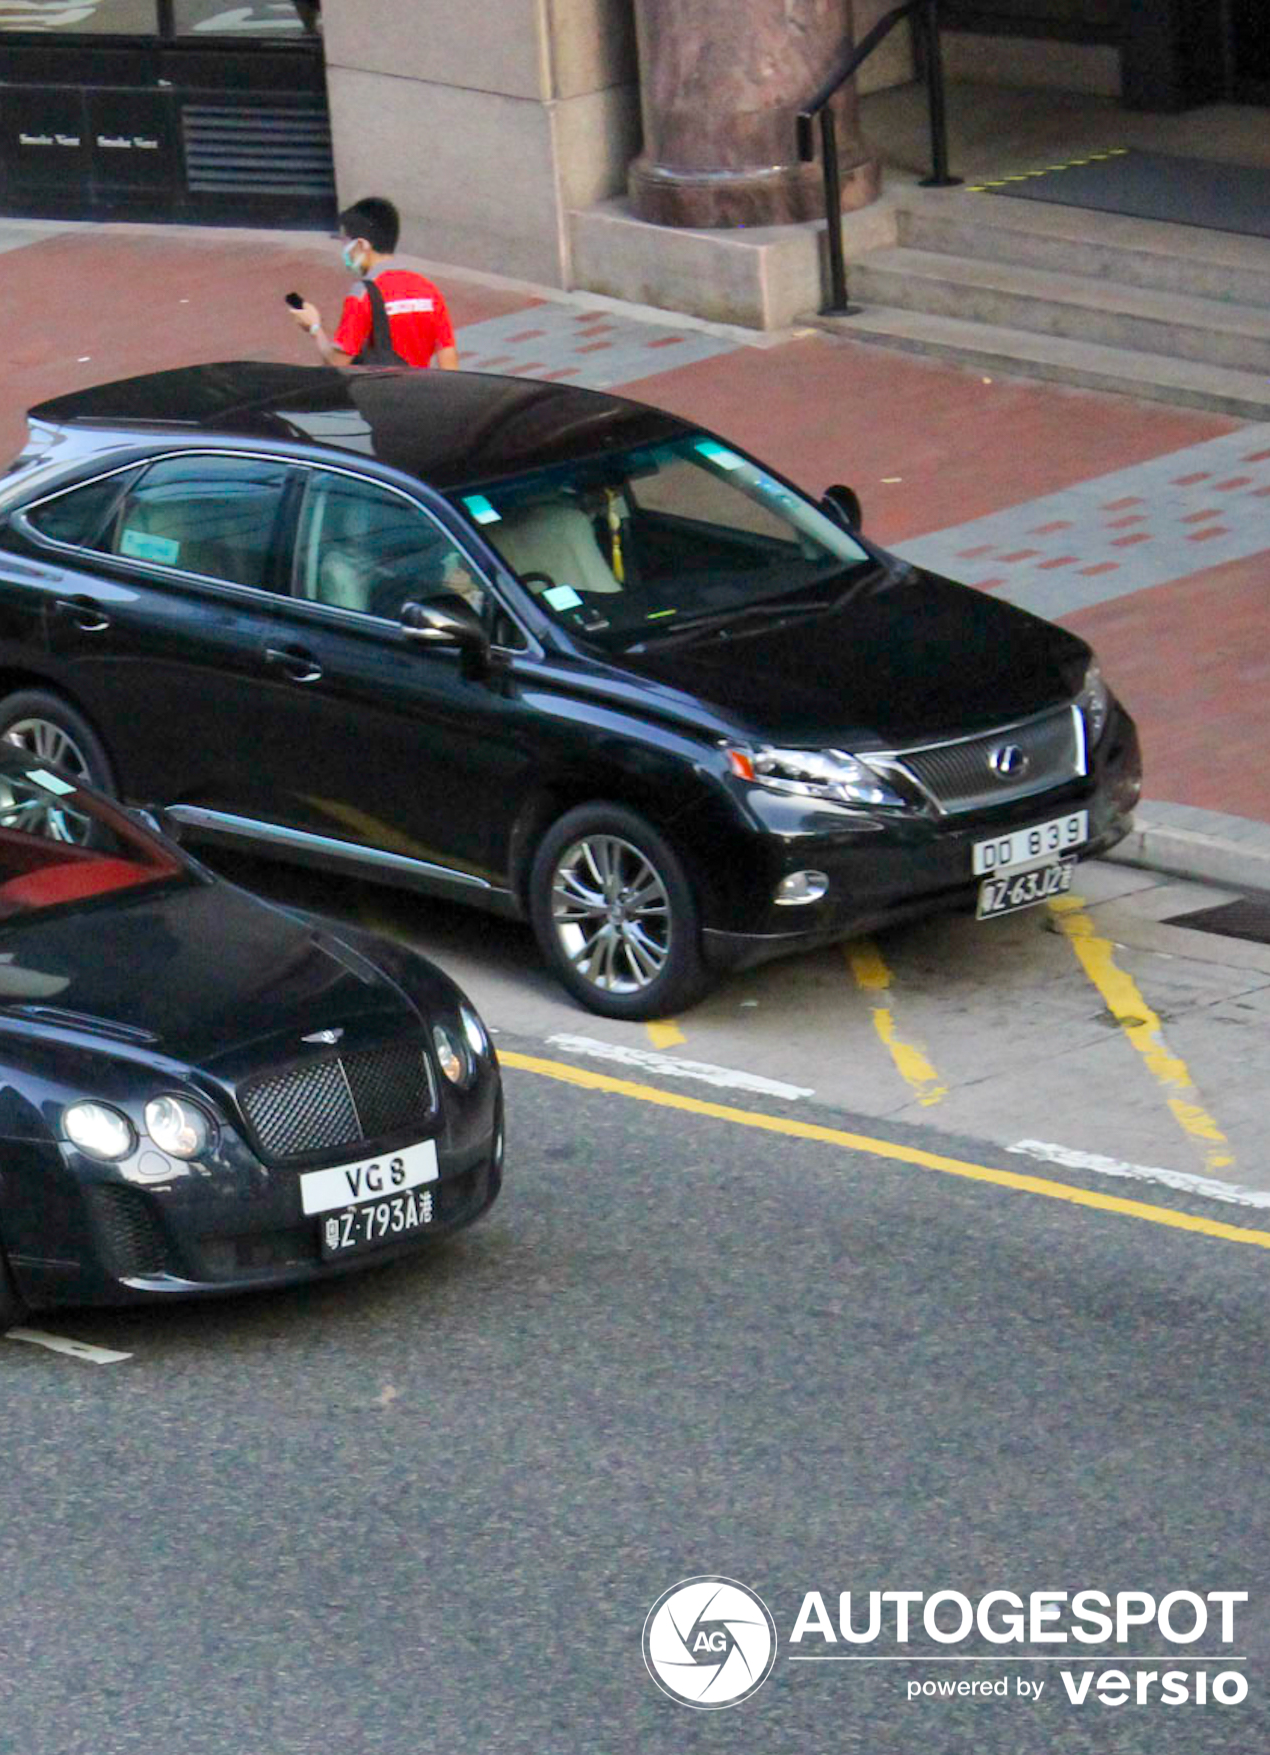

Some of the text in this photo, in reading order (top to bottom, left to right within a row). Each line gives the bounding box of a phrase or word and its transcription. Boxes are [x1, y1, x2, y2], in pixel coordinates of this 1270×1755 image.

[984, 817, 1079, 868] DD 839
[345, 1157, 405, 1197] VG 8
